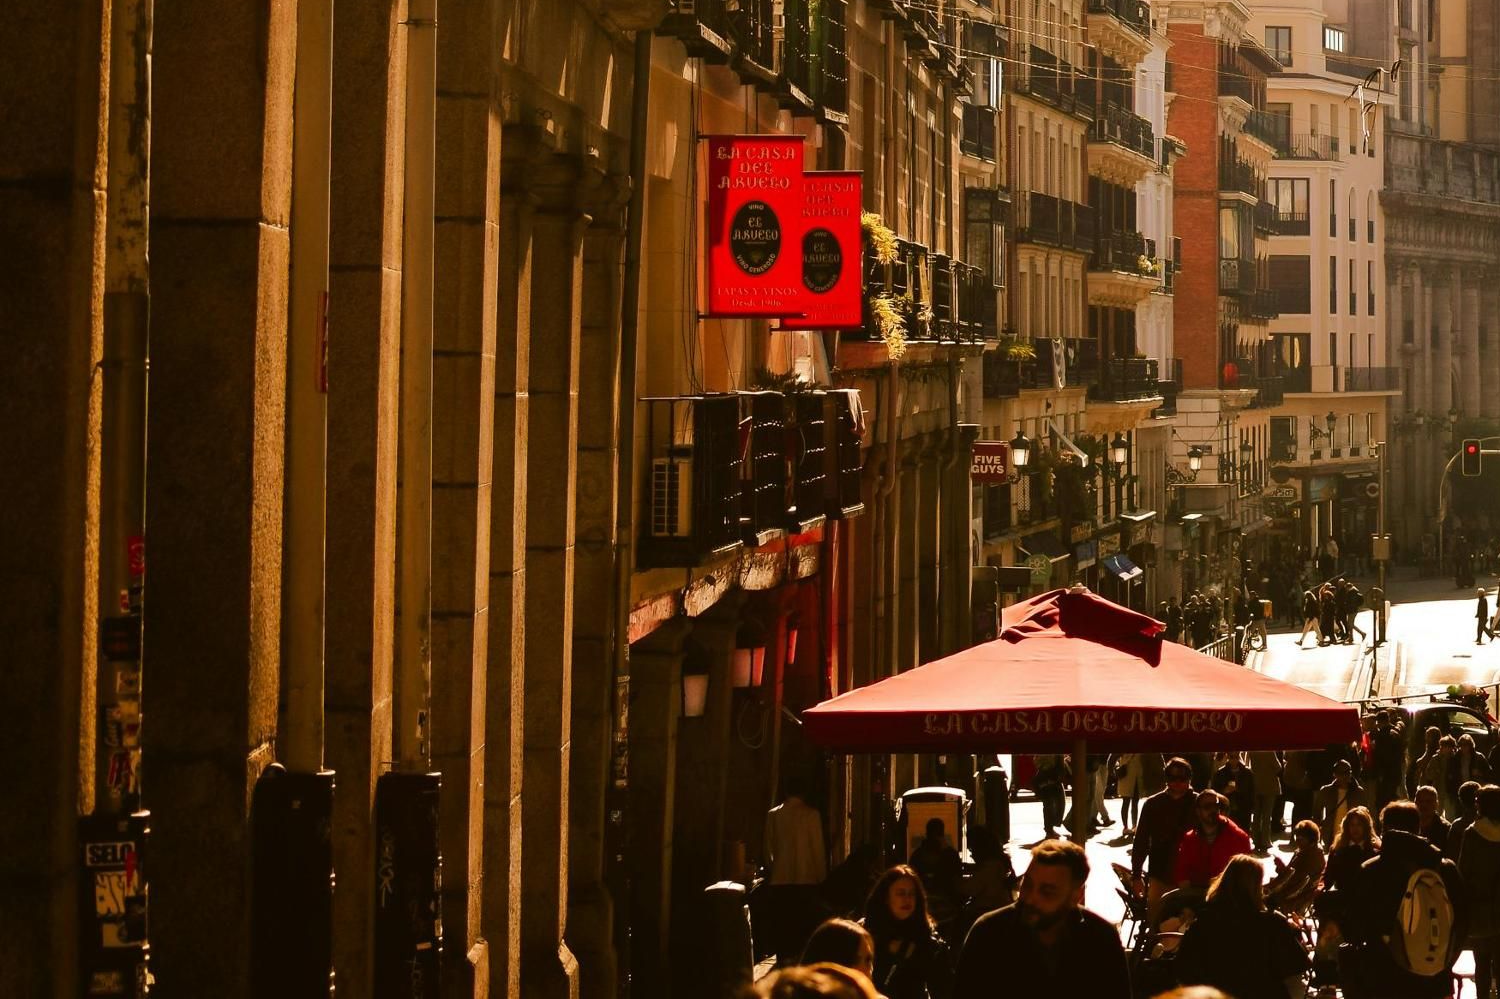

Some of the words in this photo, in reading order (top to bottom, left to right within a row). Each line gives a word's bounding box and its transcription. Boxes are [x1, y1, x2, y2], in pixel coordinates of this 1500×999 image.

[717, 147, 740, 160] LA
[746, 147, 795, 160] CASA
[739, 162, 773, 174] DEL
[717, 176, 790, 189] ABUELO
[802, 207, 849, 217] BUELO
[748, 217, 762, 228] EL
[733, 229, 779, 241] ABUELO
[763, 287, 798, 296] VINOS
[974, 455, 1001, 464] FIVE
[971, 465, 1005, 474] GUYS
[923, 713, 963, 735] LA
[970, 711, 1053, 734] CASA
[1060, 711, 1116, 732] DEL
[1124, 712, 1244, 734] ABUELO
